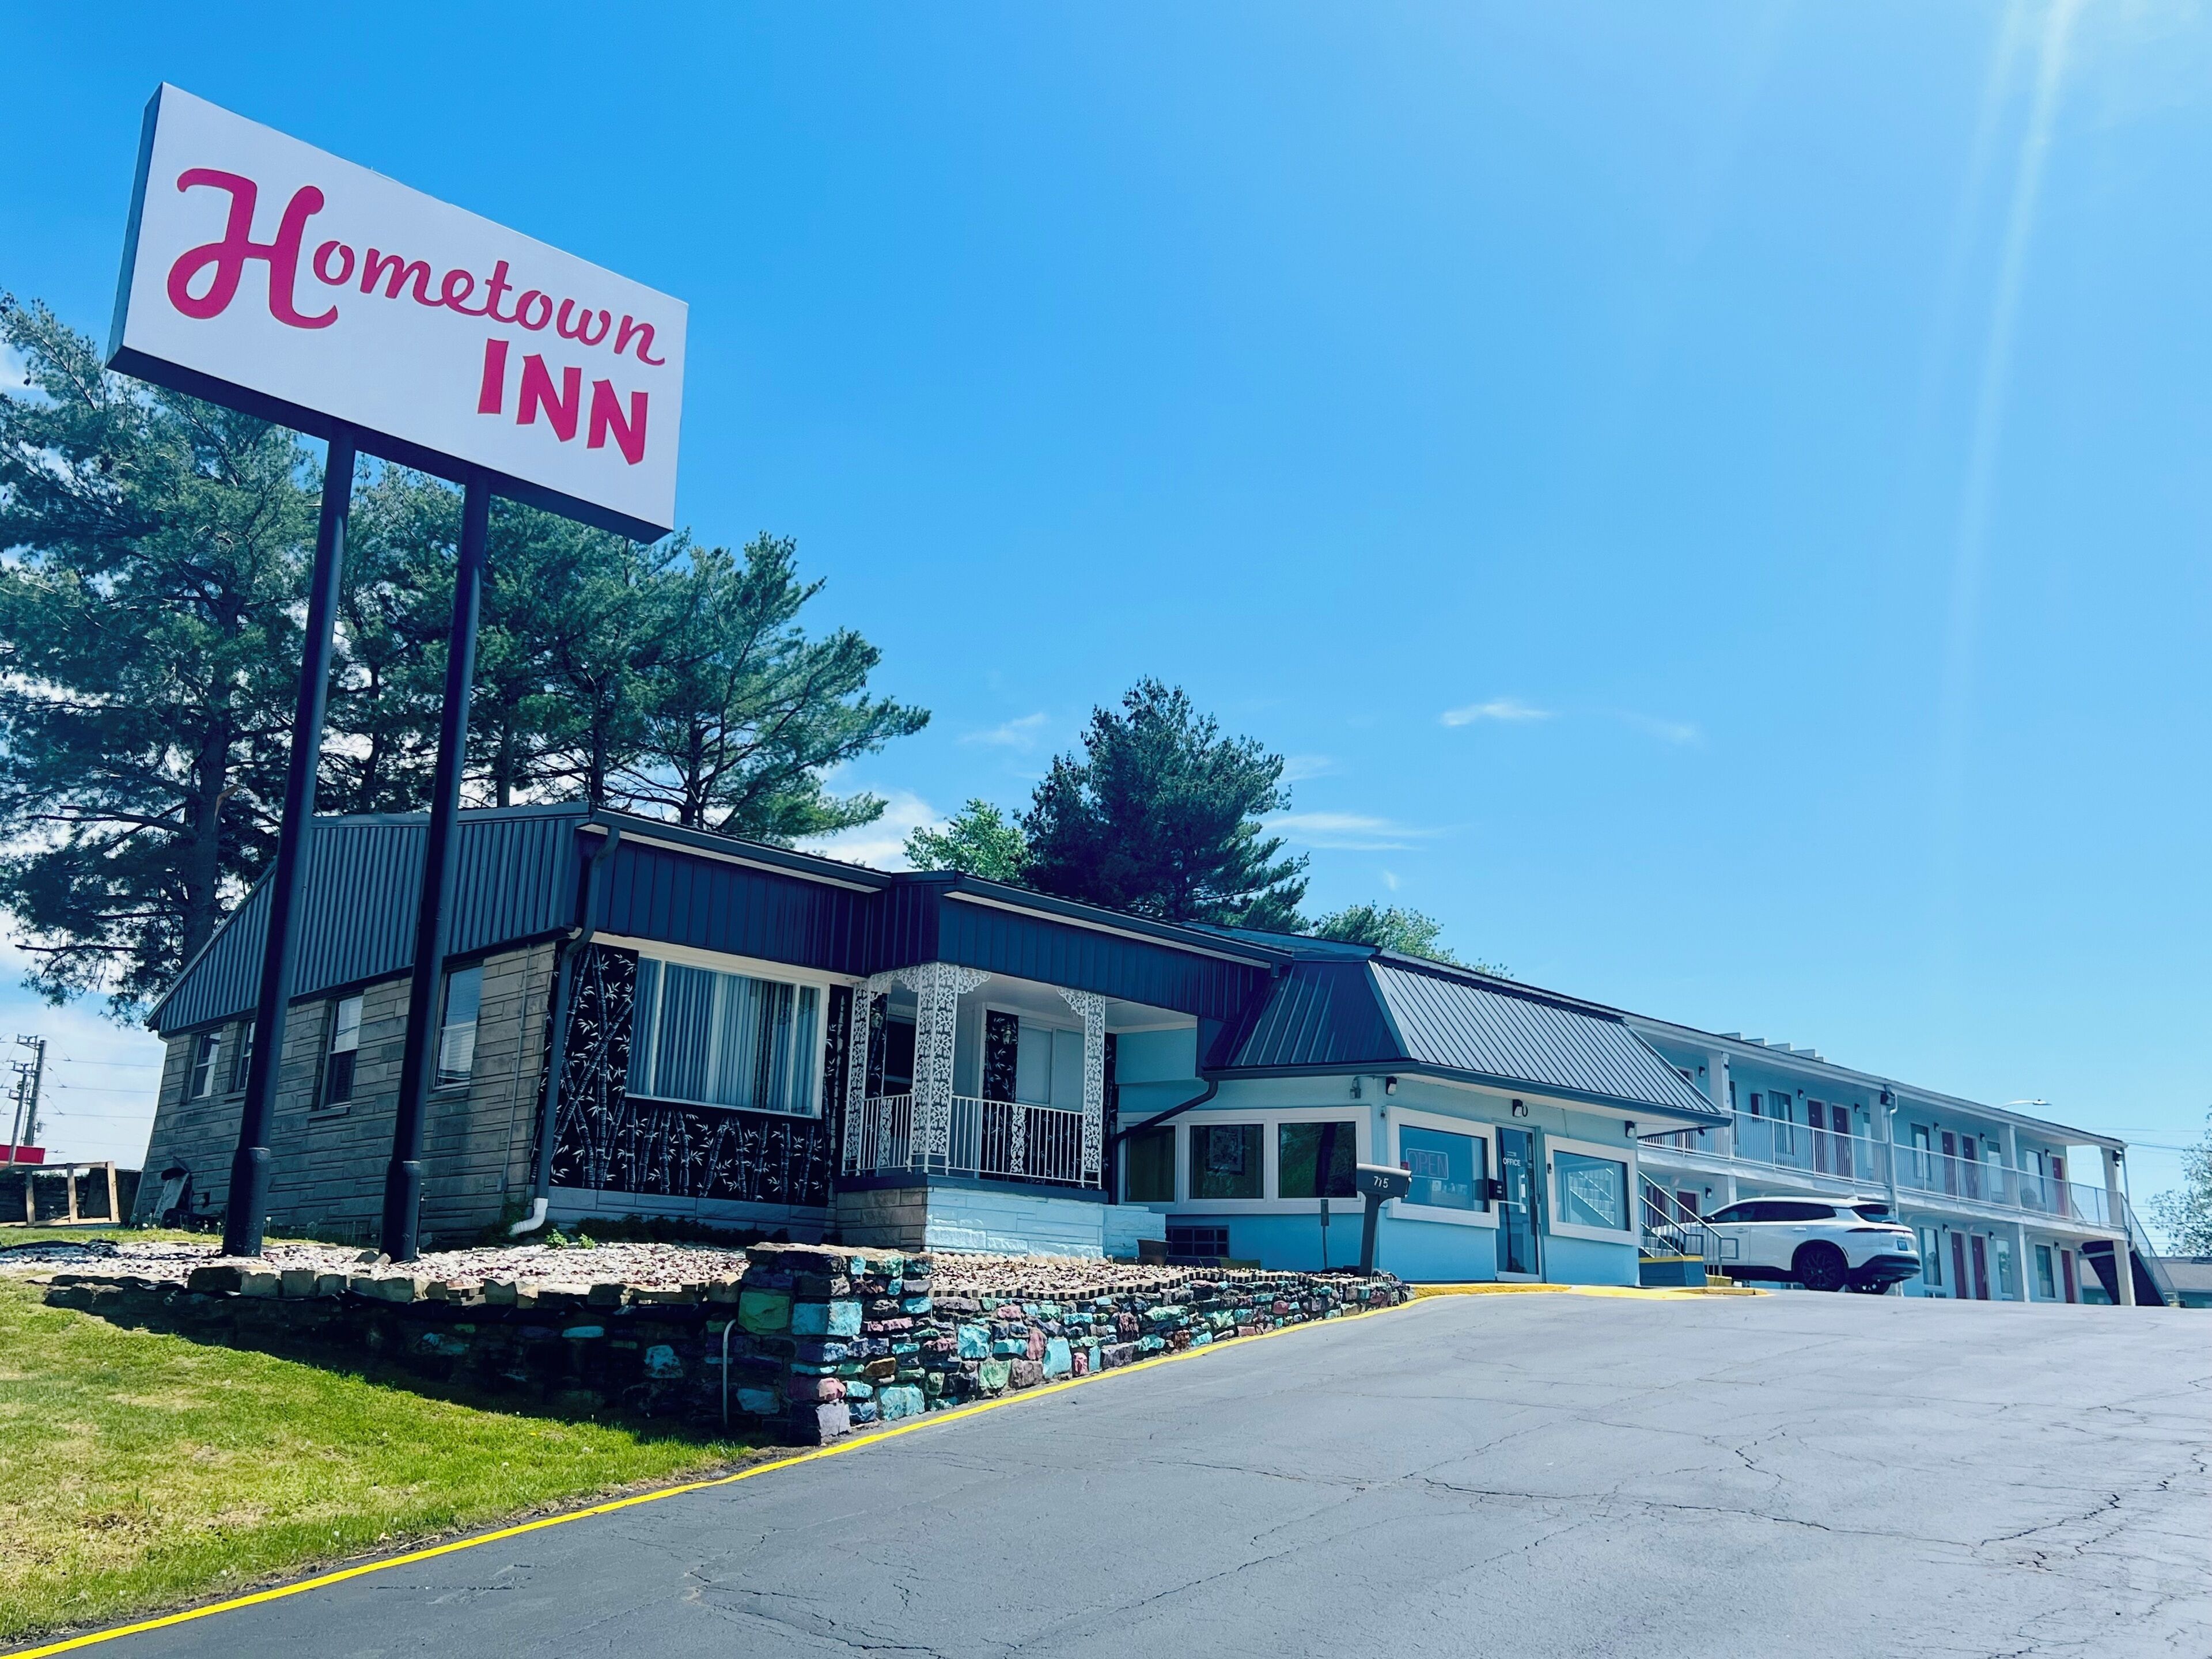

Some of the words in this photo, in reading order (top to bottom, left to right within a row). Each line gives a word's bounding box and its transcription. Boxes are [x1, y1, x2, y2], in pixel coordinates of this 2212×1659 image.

[167, 168, 665, 366] Hometown
[478, 338, 648, 465] INN
[1408, 1152, 1447, 1177] OPEN
[1502, 1157, 1521, 1166] OFFICE
[1374, 1176, 1389, 1188] 715
